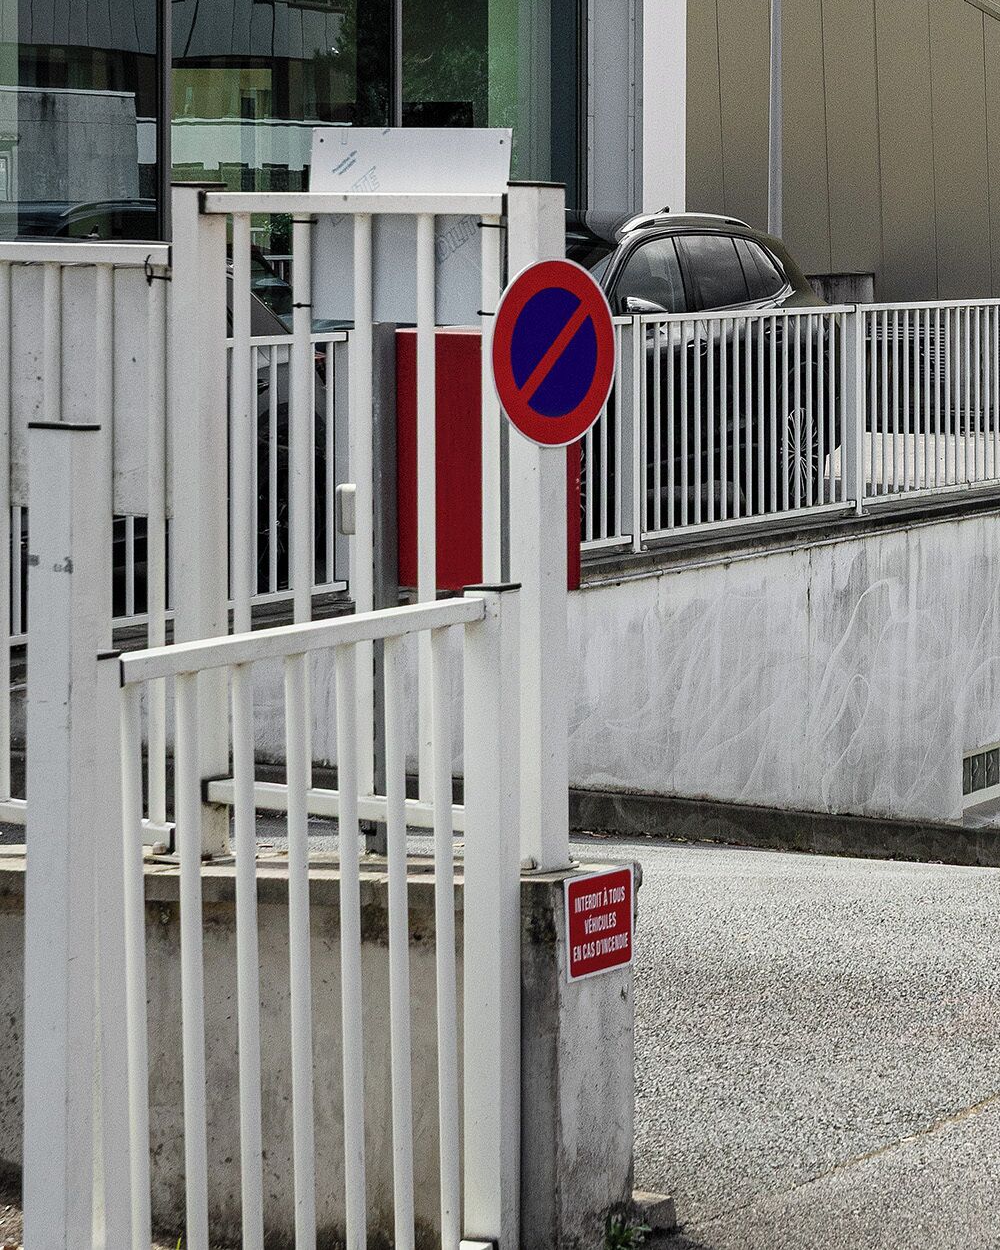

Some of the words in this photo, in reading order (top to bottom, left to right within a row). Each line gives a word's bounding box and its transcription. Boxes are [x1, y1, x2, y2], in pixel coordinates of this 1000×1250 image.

[575, 892, 602, 913] INTERDIT
[603, 887, 609, 906] À
[610, 886, 625, 903] TOUS
[584, 912, 617, 934] VÉHICULES
[573, 945, 582, 962] EN
[582, 941, 595, 960] CAS
[596, 933, 628, 955] D'INCENDIE
